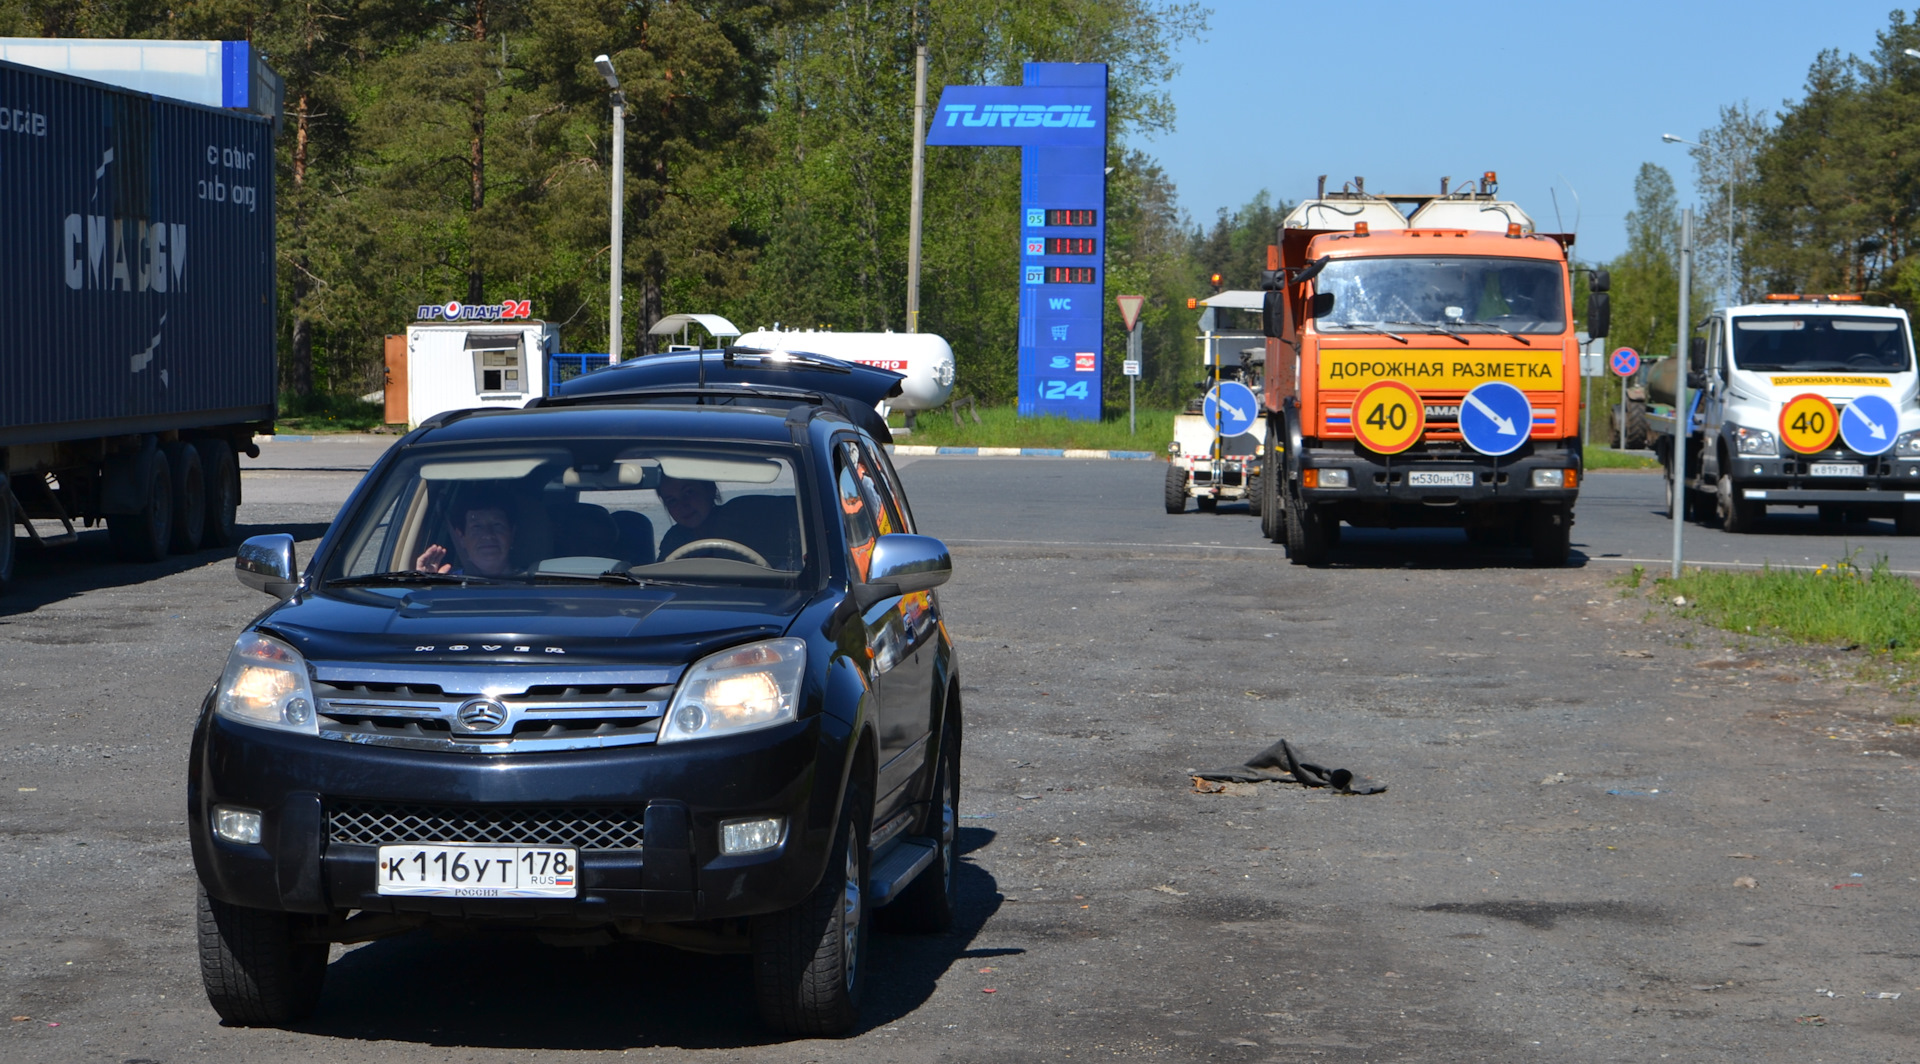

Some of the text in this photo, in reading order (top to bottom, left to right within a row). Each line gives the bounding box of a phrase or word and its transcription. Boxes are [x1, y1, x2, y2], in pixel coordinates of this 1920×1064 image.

[944, 104, 1096, 128] TURBOIL
[1028, 215, 1043, 224] 95
[1028, 243, 1043, 253] 92
[1048, 298, 1072, 310] WC
[1330, 362, 1552, 379] ДОРОЖНАЯ РАЗМЕТКА
[1045, 380, 1089, 400] 24
[1366, 403, 1407, 430] 40
[1791, 412, 1825, 434] 40
[415, 645, 565, 653] HOVER
[521, 851, 568, 875] 178
[530, 875, 555, 885] RUS
[454, 888, 499, 897] РОССИЯ
